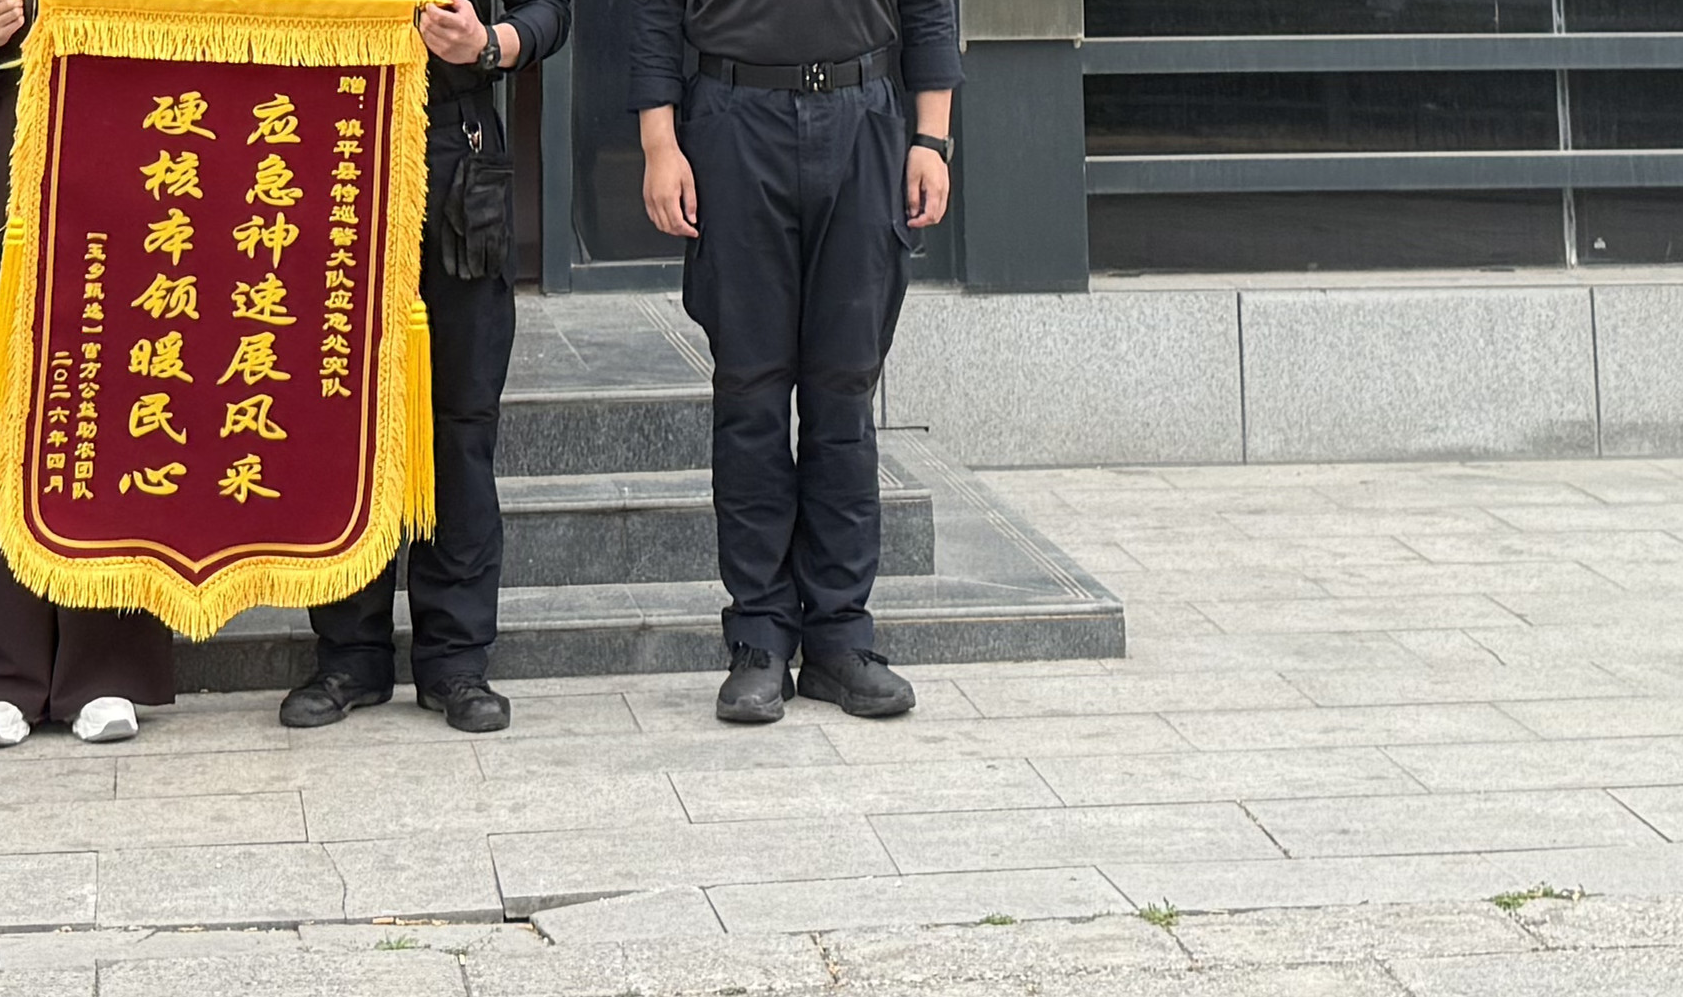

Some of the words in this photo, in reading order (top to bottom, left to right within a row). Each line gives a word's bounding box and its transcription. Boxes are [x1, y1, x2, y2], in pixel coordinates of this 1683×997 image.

[118, 90, 217, 495] 硬核本领暖民心
[216, 93, 304, 504] 应急神速展风采
